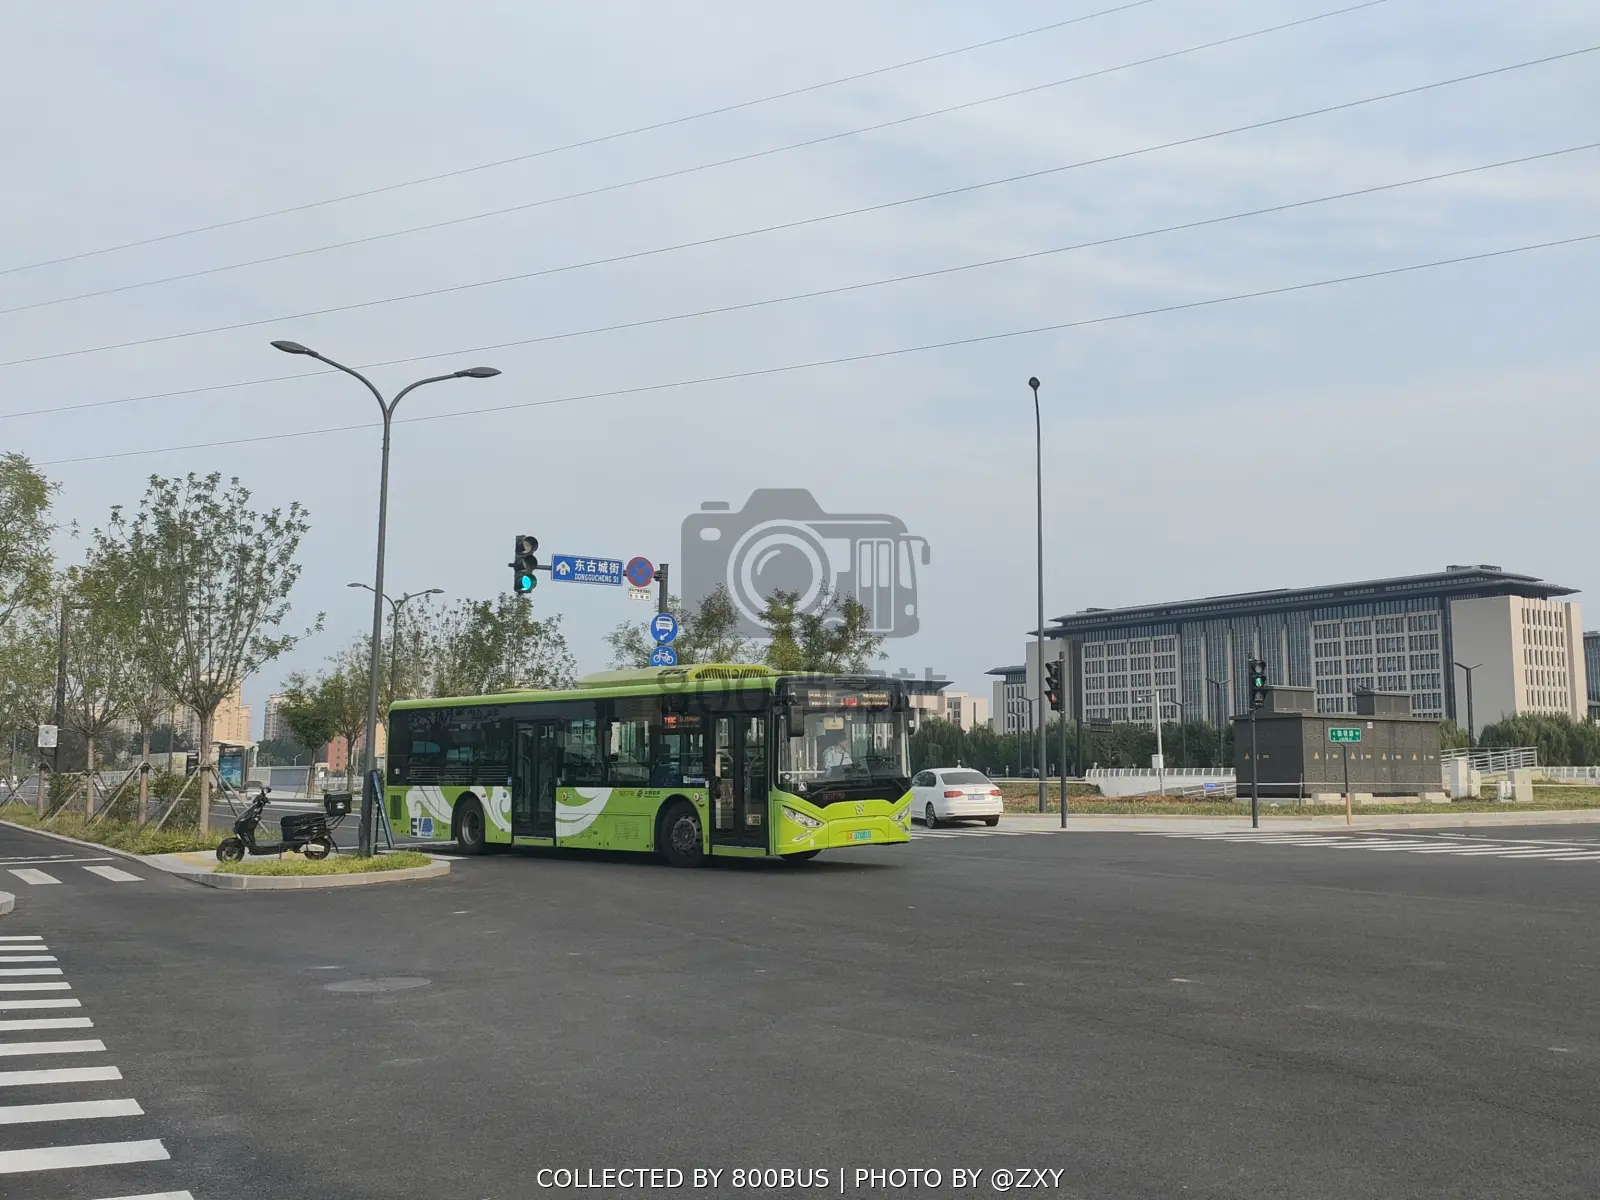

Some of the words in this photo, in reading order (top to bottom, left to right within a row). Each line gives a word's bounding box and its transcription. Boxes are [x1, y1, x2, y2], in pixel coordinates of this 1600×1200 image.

[575, 559, 619, 575] 东古城街
[574, 573, 612, 583] DONGGUCHENG
[613, 575, 619, 584] St
